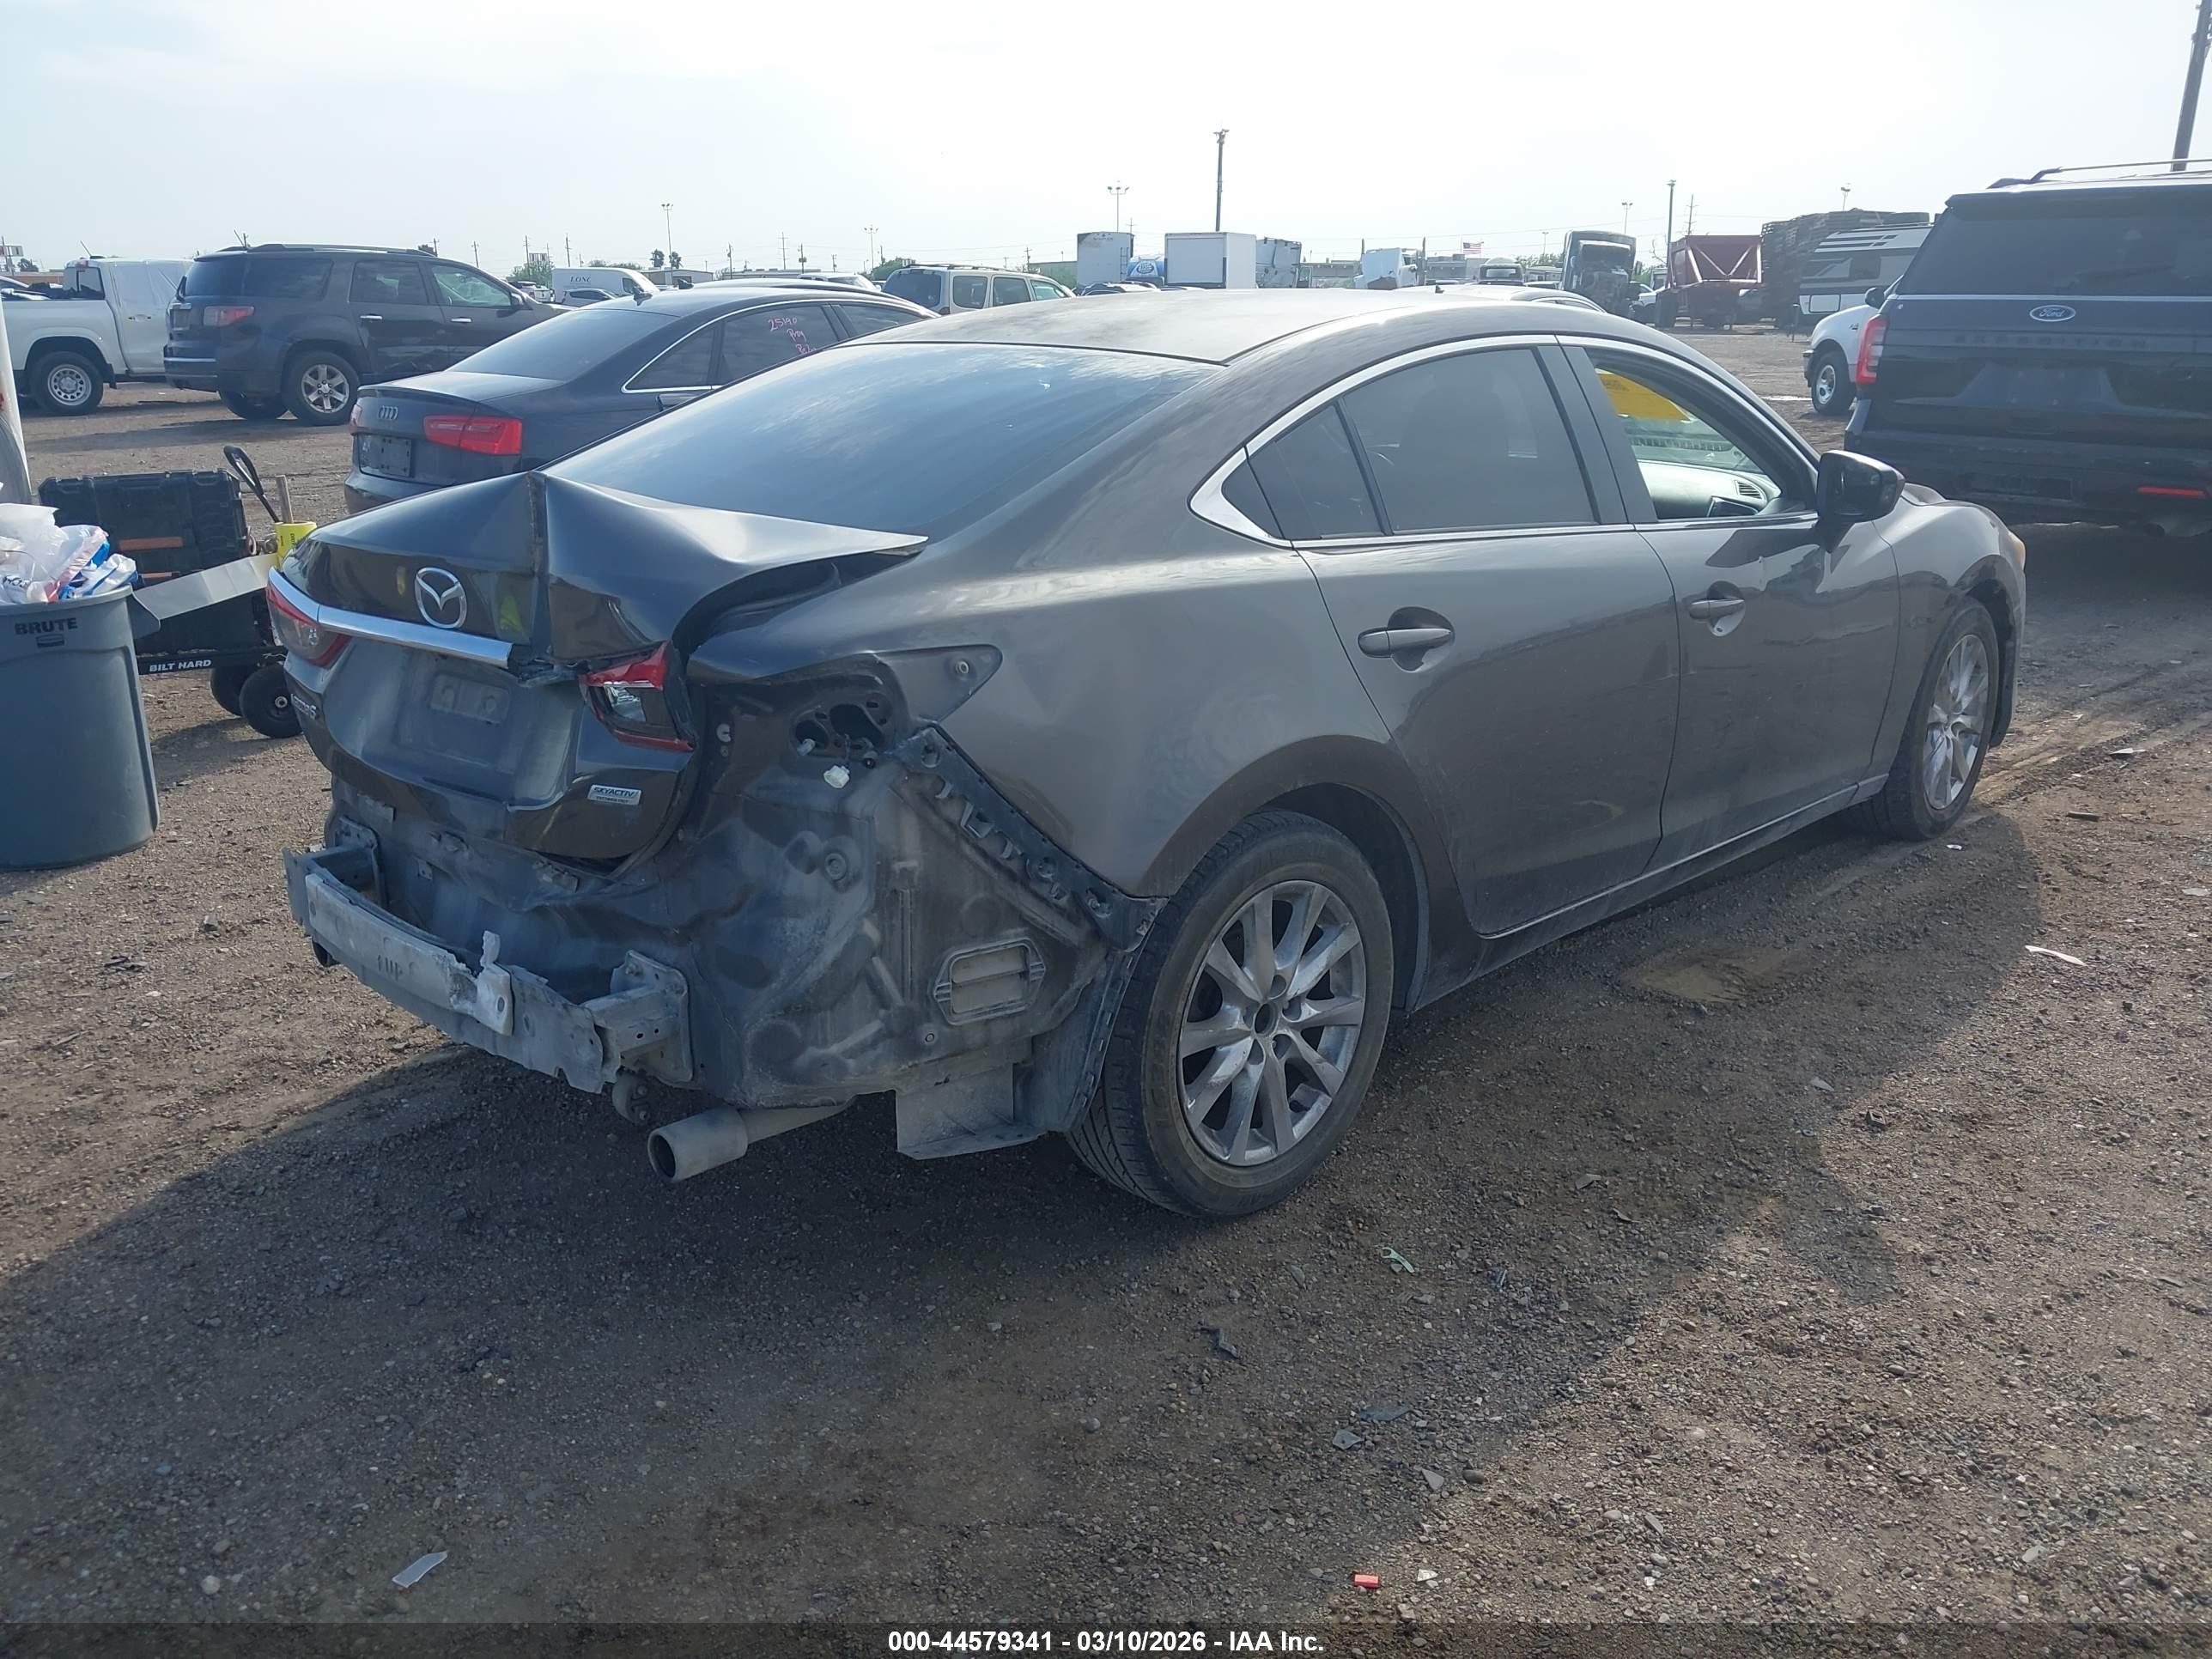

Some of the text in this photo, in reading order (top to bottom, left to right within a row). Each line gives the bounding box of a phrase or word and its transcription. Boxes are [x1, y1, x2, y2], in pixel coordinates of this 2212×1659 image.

[15, 617, 78, 635] BRUTE
[149, 659, 212, 672] BILT HARD
